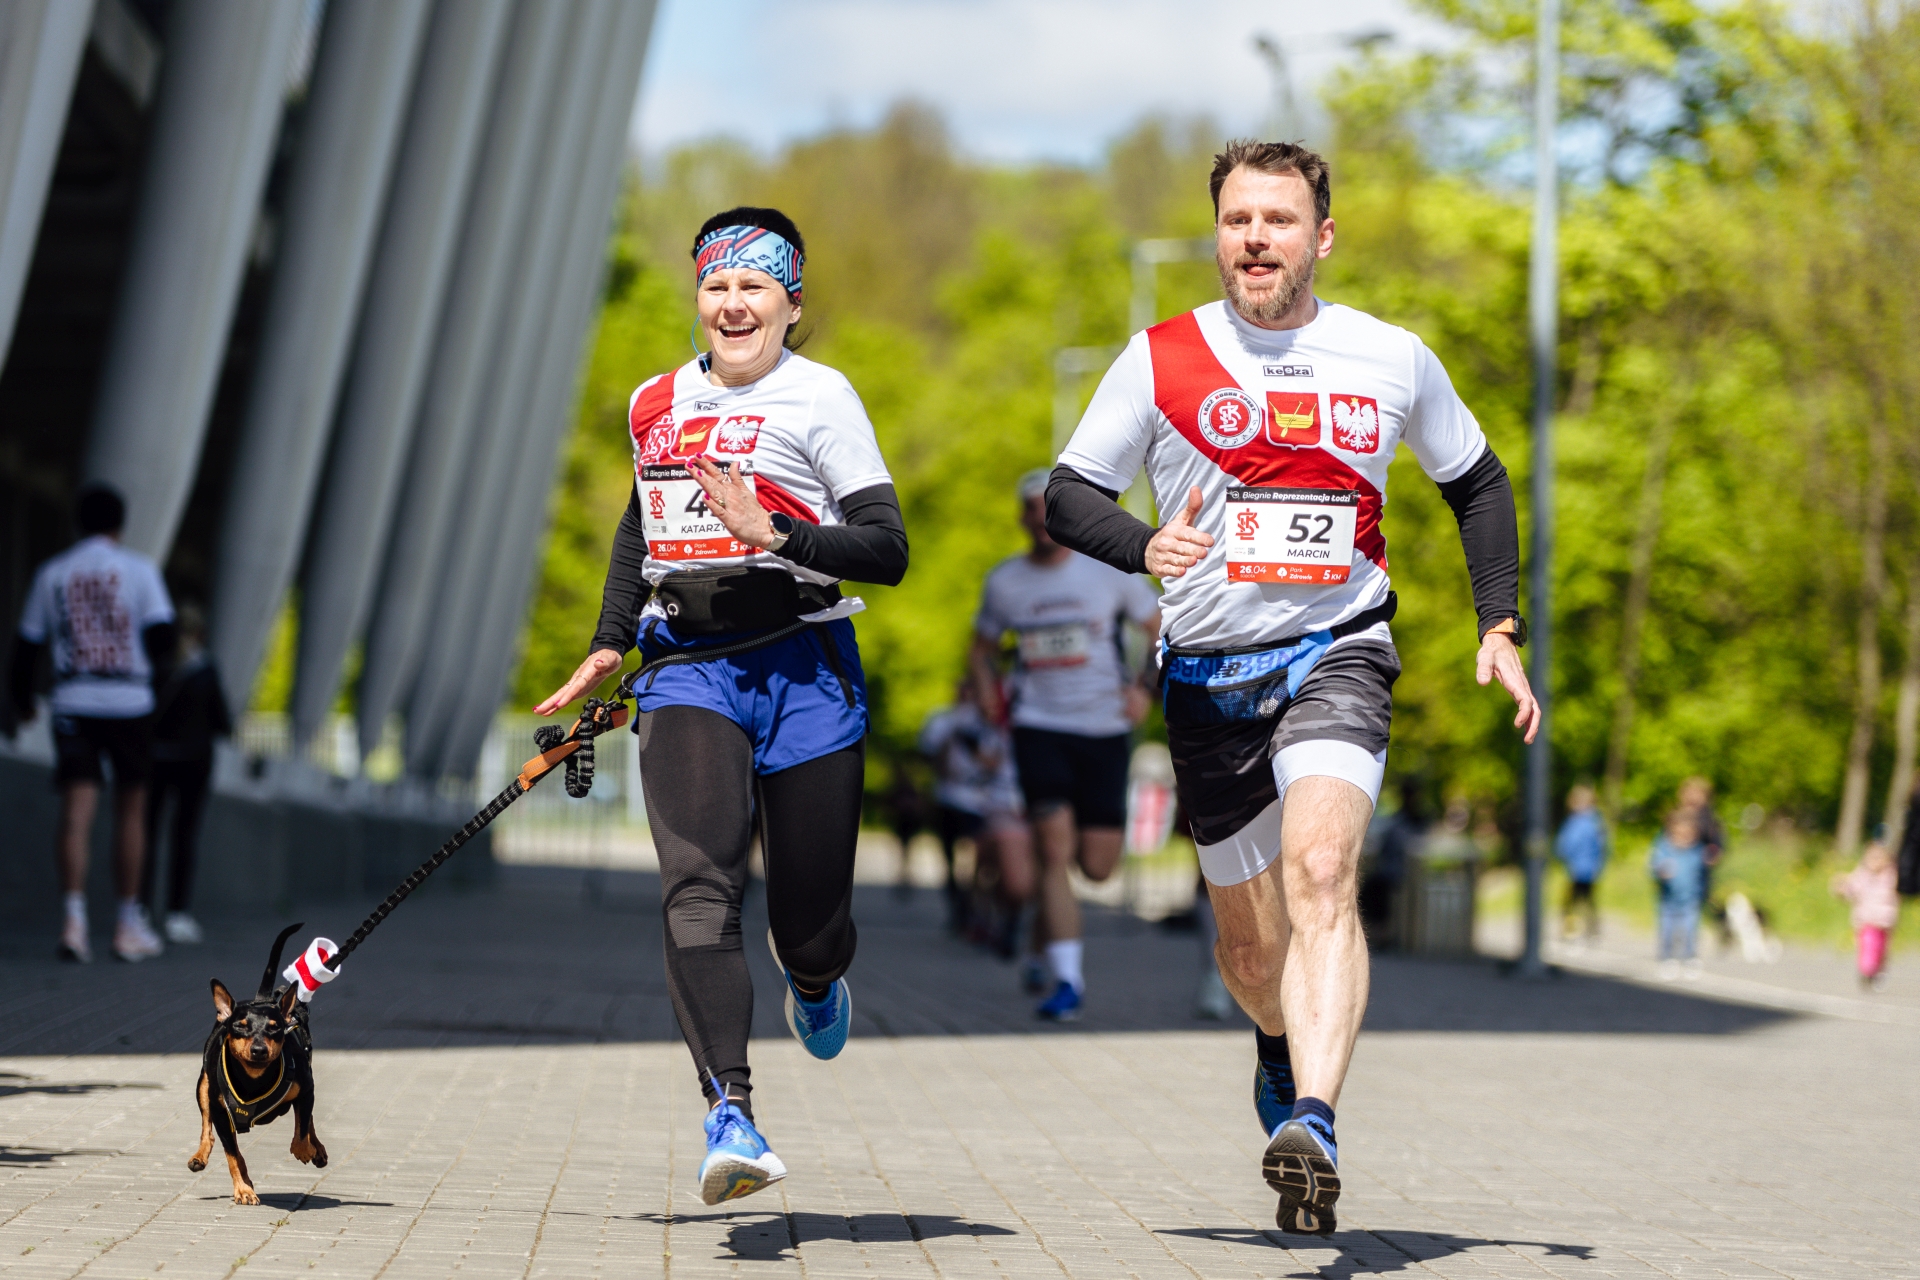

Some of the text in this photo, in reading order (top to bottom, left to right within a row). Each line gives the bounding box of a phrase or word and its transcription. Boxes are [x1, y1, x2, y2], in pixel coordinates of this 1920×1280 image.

[1266, 366, 1310, 376] keeza
[649, 469, 670, 477] Biegnie
[1242, 491, 1272, 500] Biegnie
[1272, 492, 1330, 503] Reprezentacja
[684, 488, 717, 519] 4
[680, 522, 726, 534] KATARZY
[1285, 513, 1334, 544] 52
[657, 543, 677, 552] 26.04
[729, 541, 739, 552] 5
[1287, 549, 1331, 559] MARCIN
[1239, 565, 1267, 574] 26.04
[1323, 569, 1331, 580] 5
